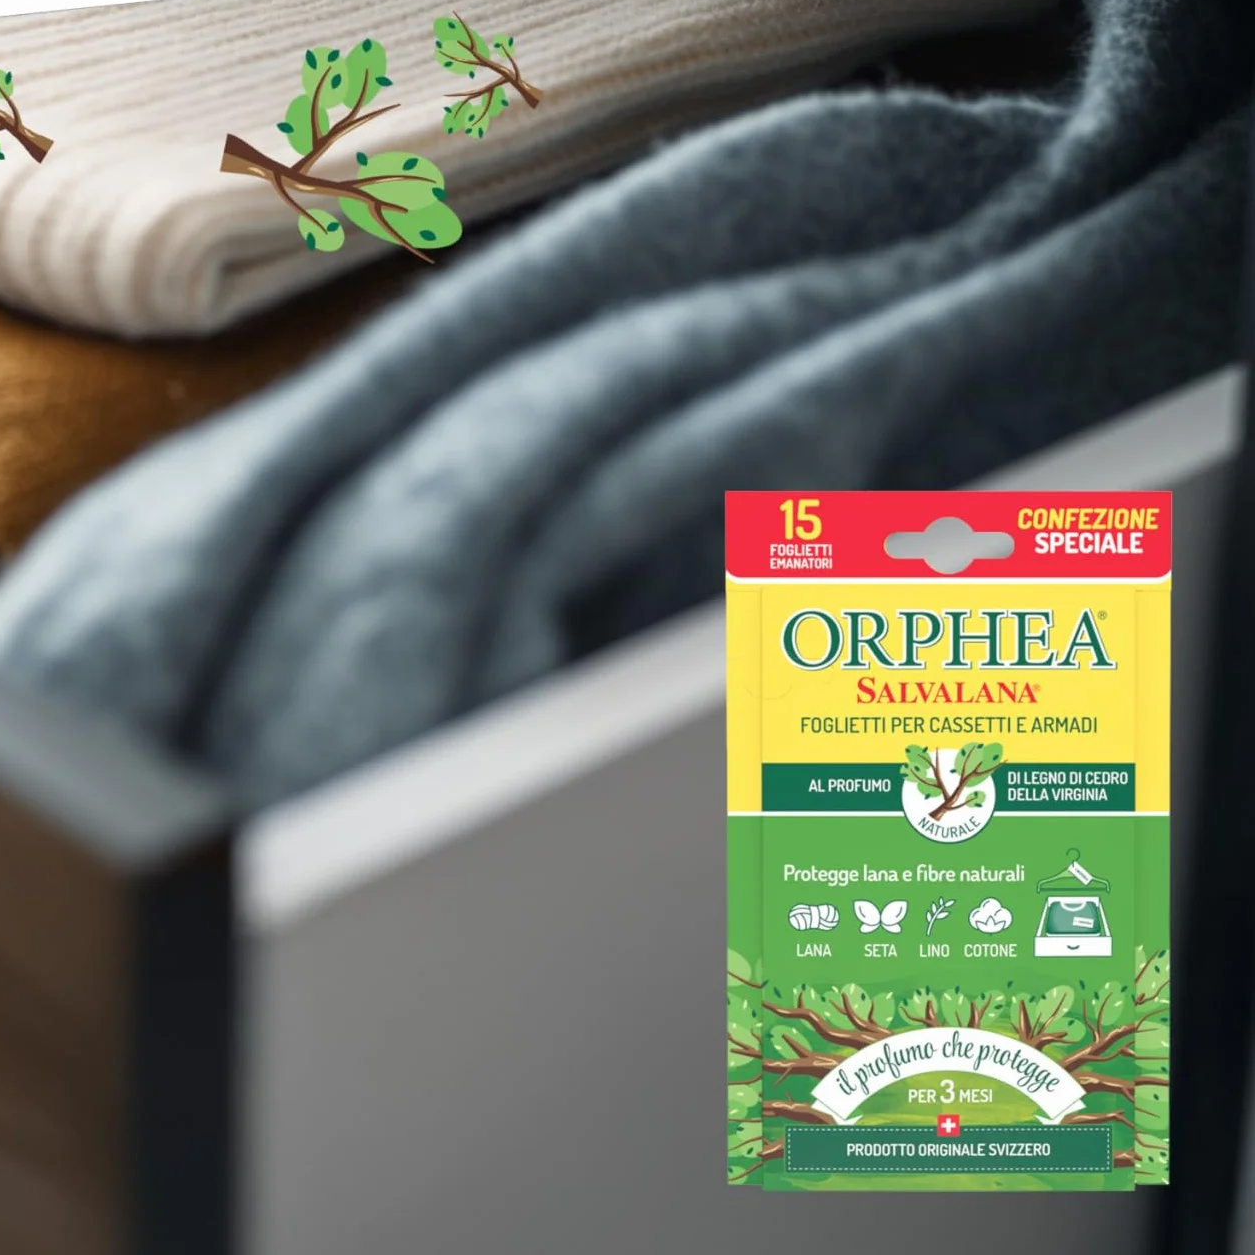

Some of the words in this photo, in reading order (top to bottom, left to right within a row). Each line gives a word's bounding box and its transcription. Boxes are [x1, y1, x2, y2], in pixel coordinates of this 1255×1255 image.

[779, 499, 822, 540] 15
[1017, 508, 1159, 530] CONFEZIONE
[770, 544, 832, 556] FOGLIETTI
[1034, 532, 1143, 554] SPECIALE
[770, 558, 832, 569] EMANATORI
[801, 716, 886, 734] FOGLIETTI
[891, 716, 925, 734] PER
[929, 716, 1011, 734] CASSETTI
[1016, 717, 1026, 733] E
[1031, 716, 1097, 734] ARMADI
[1008, 772, 1020, 785] DI
[1023, 771, 1066, 785] LEGNO
[1069, 772, 1081, 785] DI
[1085, 771, 1128, 785] CEDRO
[808, 779, 825, 792] AL
[828, 779, 891, 793] PROFUMO
[1008, 788, 1048, 801] DELLA
[1051, 788, 1108, 801] VIRGINIA
[917, 815, 981, 839] NATURALE
[784, 864, 859, 886] Protegge
[862, 864, 898, 883] lana
[902, 869, 912, 883] e
[916, 864, 955, 883] fibre
[959, 864, 1025, 883] naturali
[796, 944, 832, 958] LANA
[864, 943, 898, 958] SETA
[919, 943, 950, 958] LINO
[964, 943, 1017, 958] COTONE
[835, 1072, 857, 1096] il
[854, 1042, 938, 1088] profumo
[942, 1031, 974, 1059] che
[973, 1045, 1060, 1093] protegge
[908, 1089, 936, 1103] PER
[940, 1079, 955, 1103] 3
[959, 1089, 993, 1103] MESI
[846, 1143, 915, 1157] PRODOTTO
[918, 1143, 985, 1157] ORIGINALE
[988, 1143, 1051, 1157] SVIZZERO
